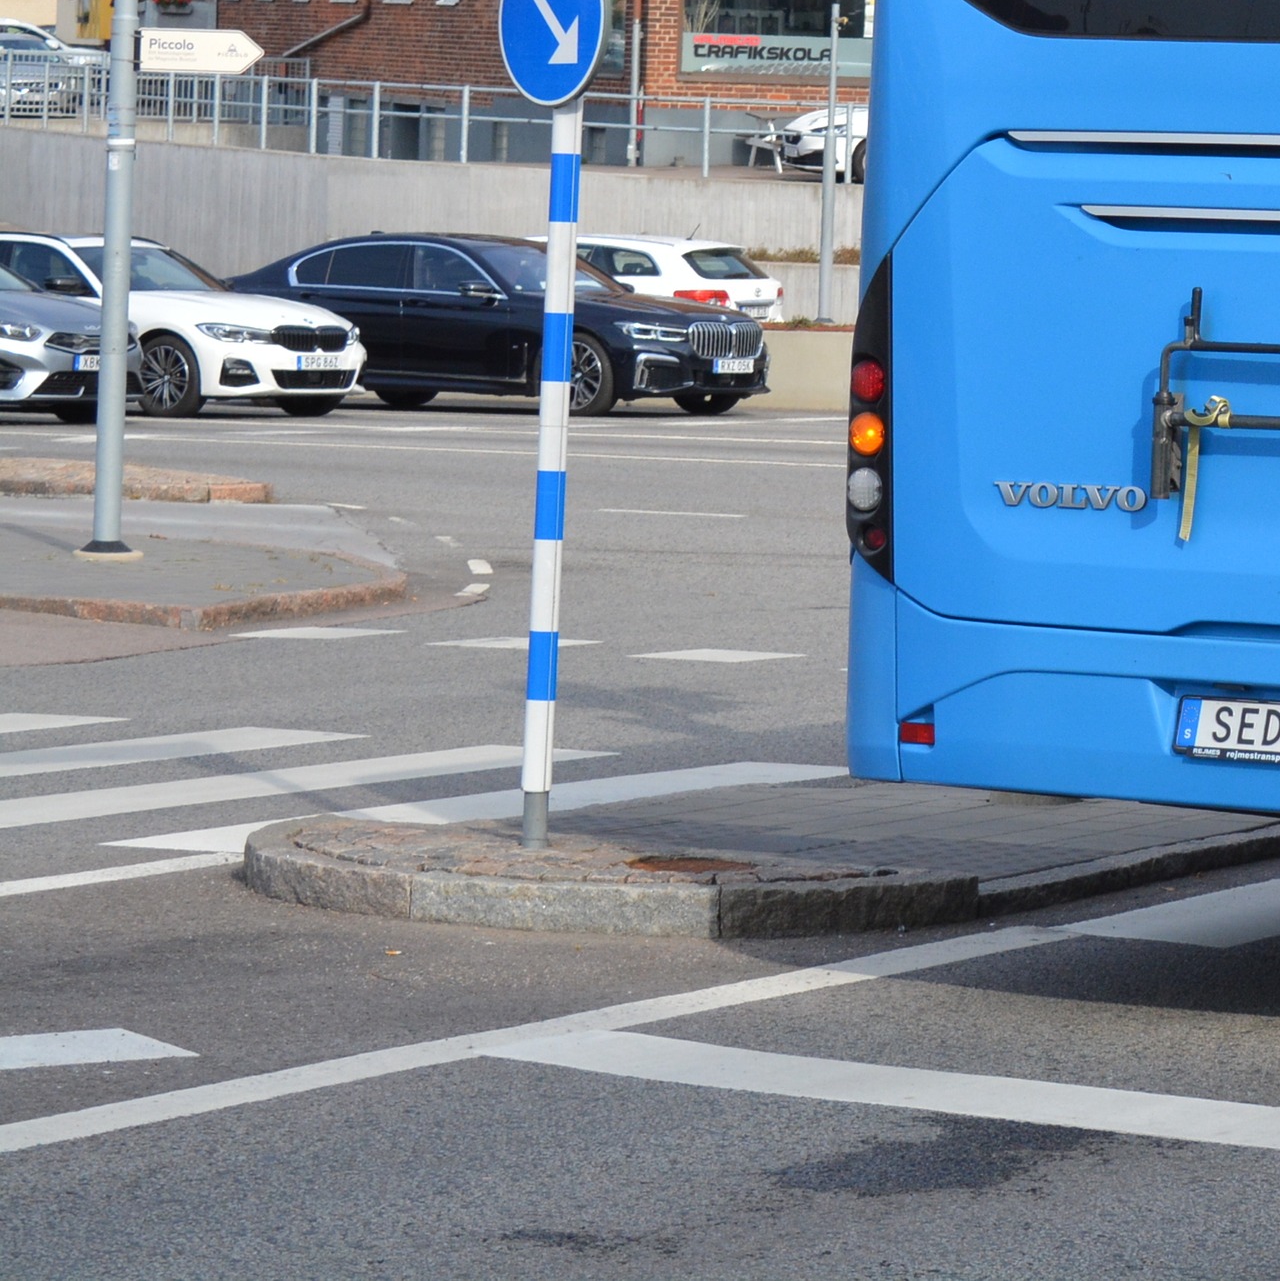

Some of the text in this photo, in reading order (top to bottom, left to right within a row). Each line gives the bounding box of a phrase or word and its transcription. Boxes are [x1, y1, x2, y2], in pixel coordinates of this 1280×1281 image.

[149, 38, 195, 51] Piccolo
[693, 44, 832, 62] TRAFIKSKOLA
[994, 480, 1147, 512] VOLVO
[1183, 728, 1192, 739] S
